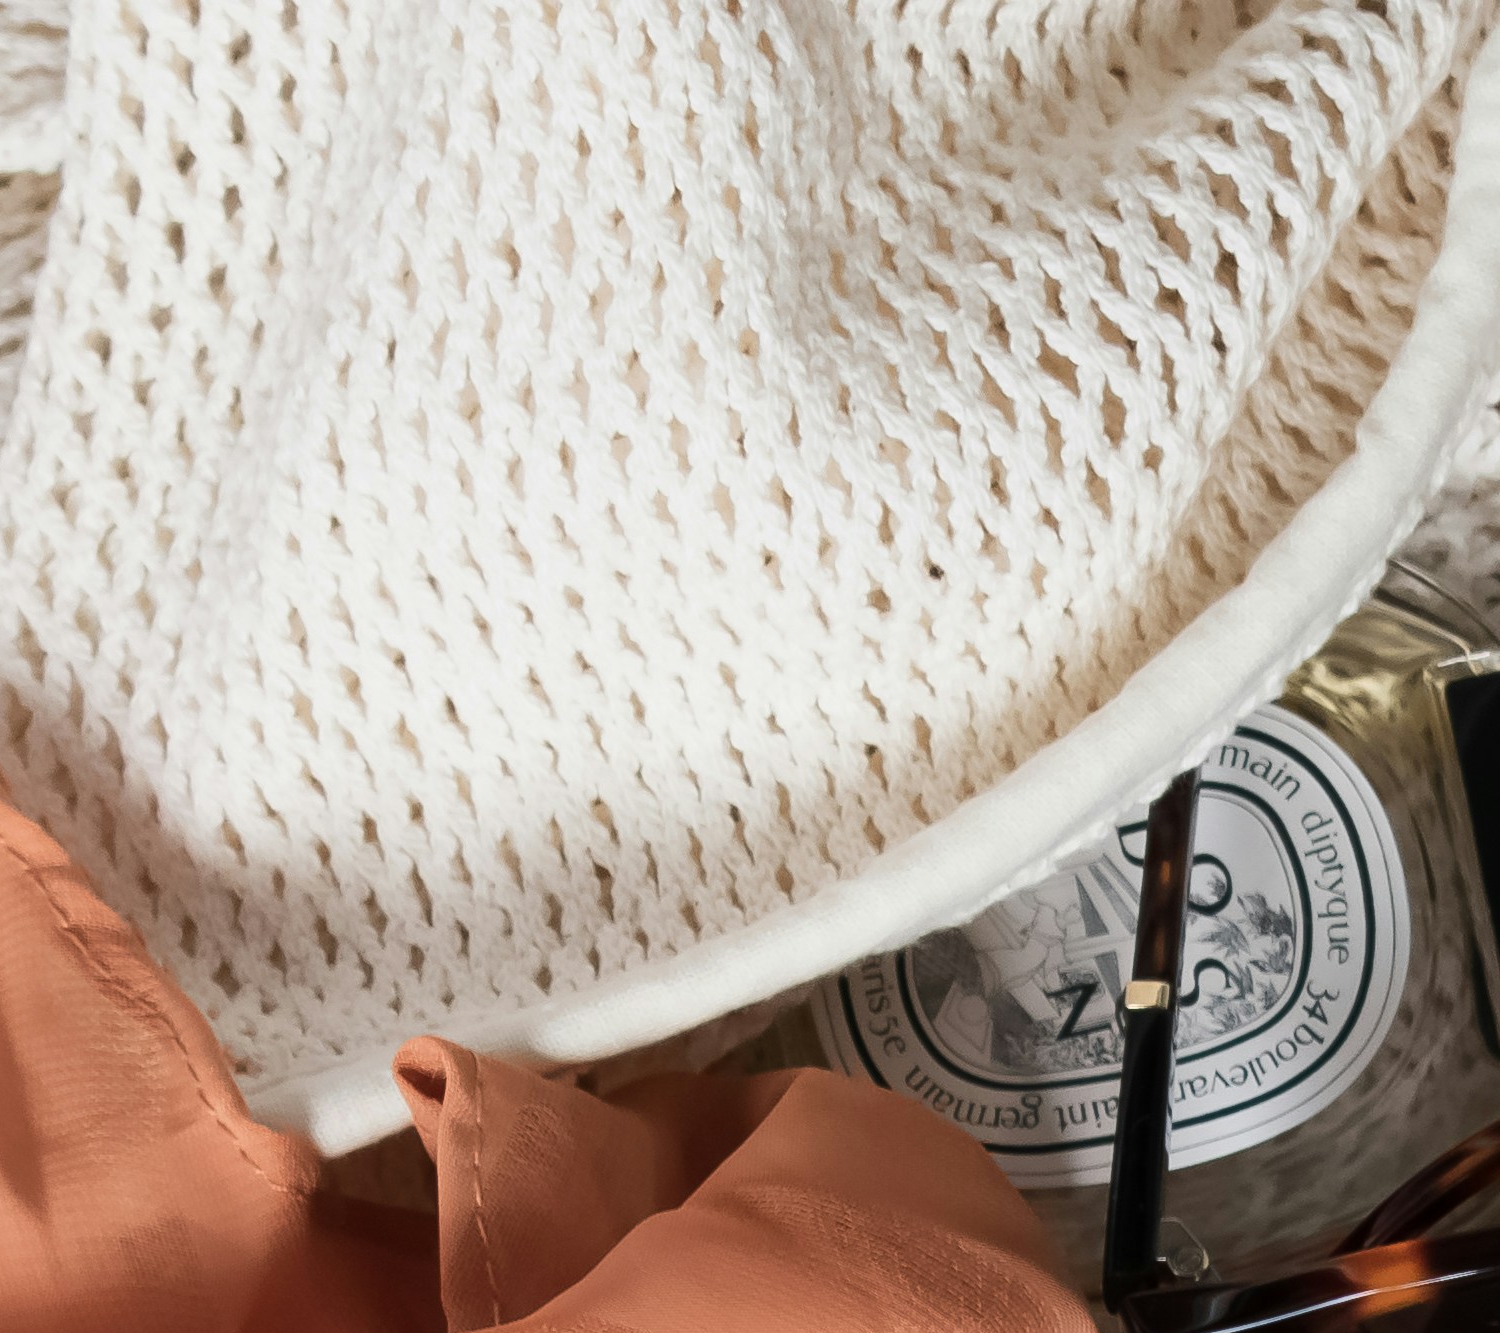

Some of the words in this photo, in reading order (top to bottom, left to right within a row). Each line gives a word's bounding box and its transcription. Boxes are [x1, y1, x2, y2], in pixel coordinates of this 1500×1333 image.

[1206, 743, 1302, 801] main
[1301, 809, 1352, 967] diptyque
[902, 1064, 1045, 1131] germain
[1054, 1096, 1120, 1133] aint
